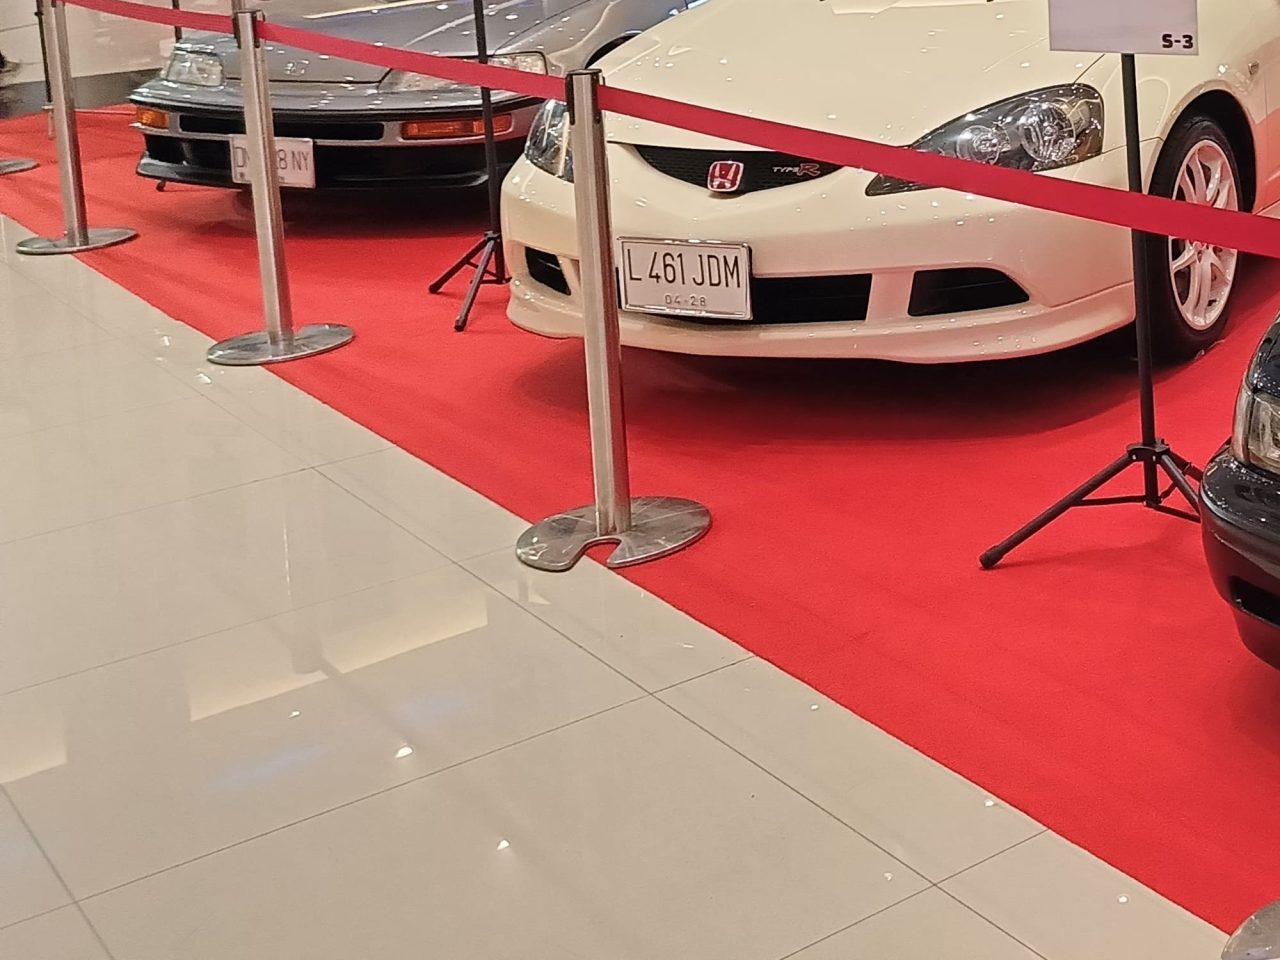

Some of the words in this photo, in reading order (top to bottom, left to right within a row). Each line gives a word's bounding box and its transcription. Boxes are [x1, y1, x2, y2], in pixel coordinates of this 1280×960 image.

[1162, 33, 1194, 49] S-3
[291, 150, 310, 171] NY
[627, 249, 642, 281] L
[648, 252, 686, 285] 461
[692, 254, 741, 288] JDM
